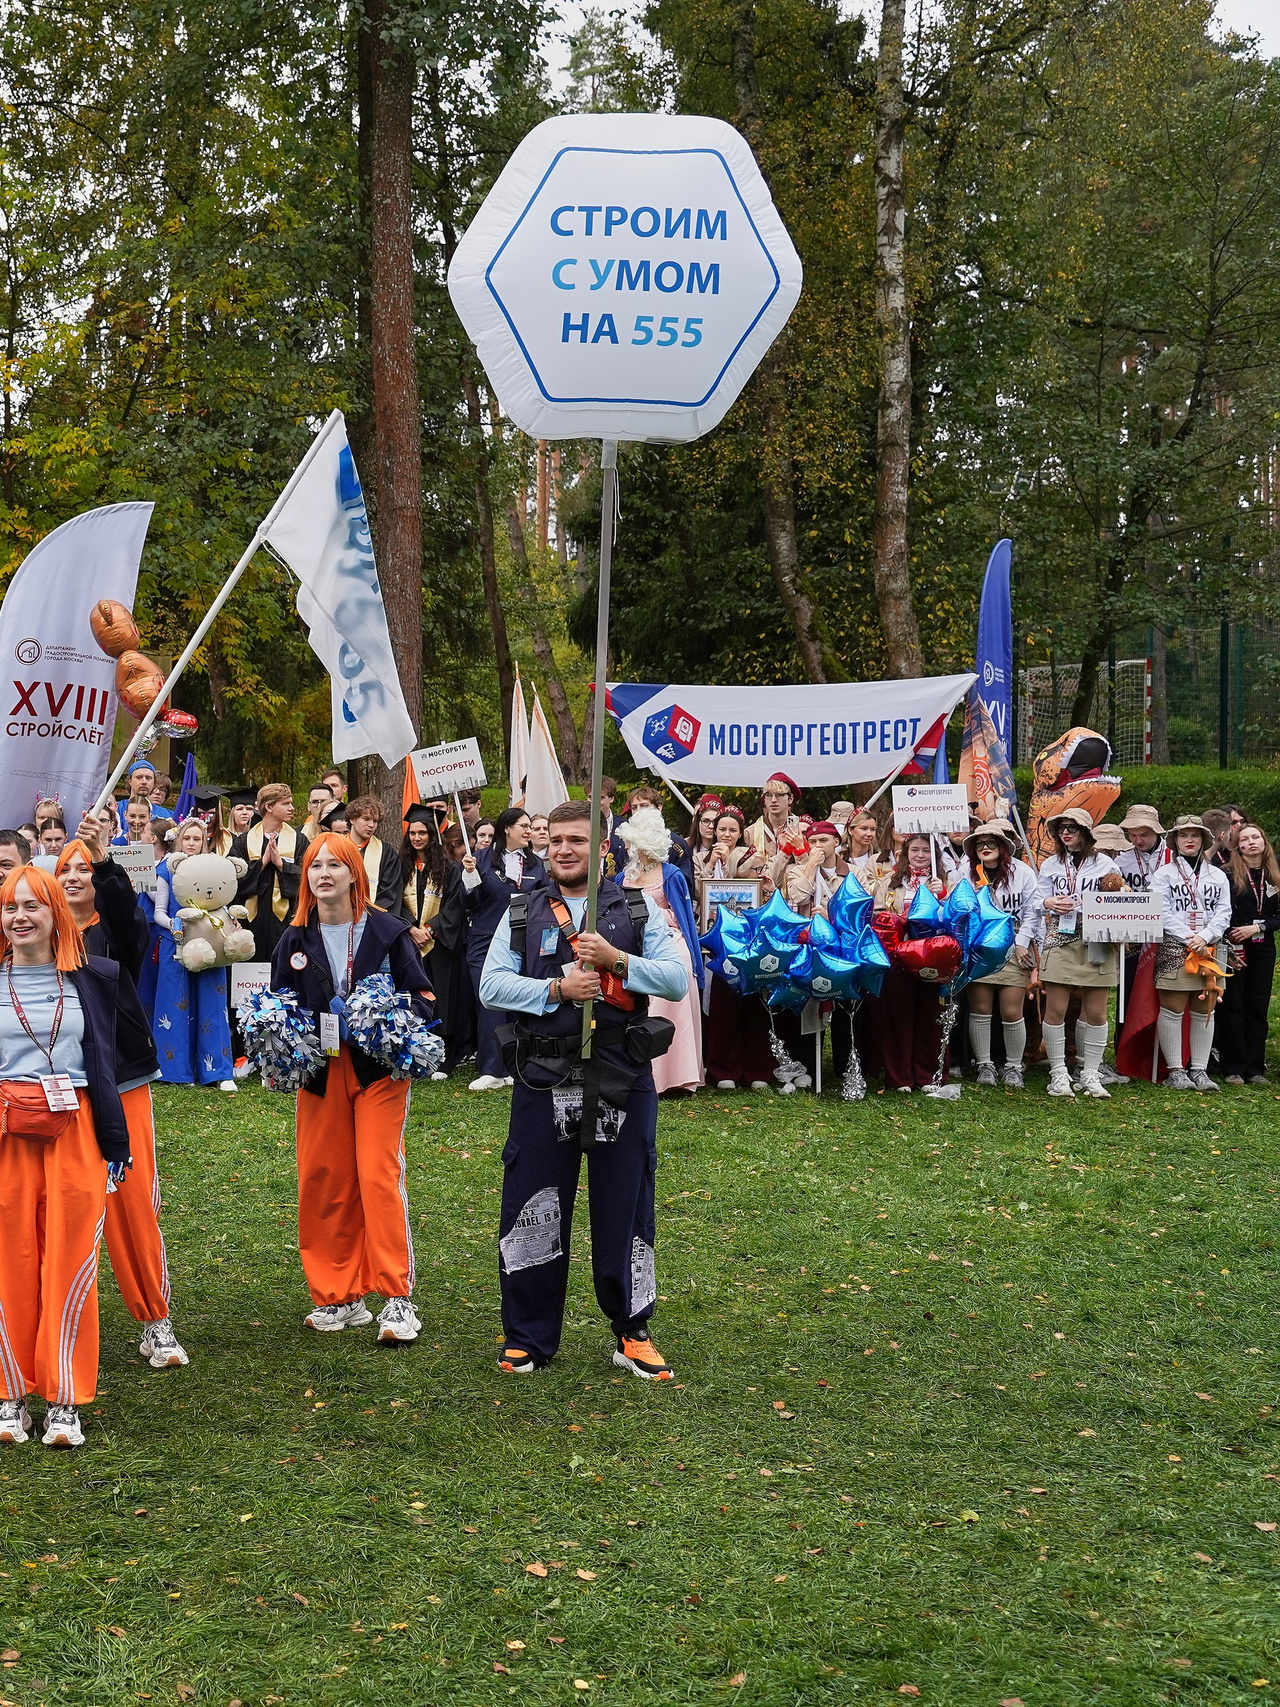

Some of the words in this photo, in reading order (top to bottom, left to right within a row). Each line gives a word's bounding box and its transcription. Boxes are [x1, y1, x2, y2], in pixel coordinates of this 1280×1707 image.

[549, 205, 727, 240] СТРОИМ
[551, 258, 577, 290] С
[588, 258, 720, 295] УМОМ
[561, 312, 619, 344] НА
[631, 315, 703, 348] 555
[8, 680, 109, 726] XVIII
[6, 720, 104, 746] СТРОЙСЛЁТ
[709, 717, 921, 756] МОСГОРГЕОТРЕСТ
[421, 759, 475, 777] МОСГОРБТИ
[428, 744, 467, 758] МОСГОРБТИ
[1103, 896, 1150, 904] МОСИНЖПРОЕКТ
